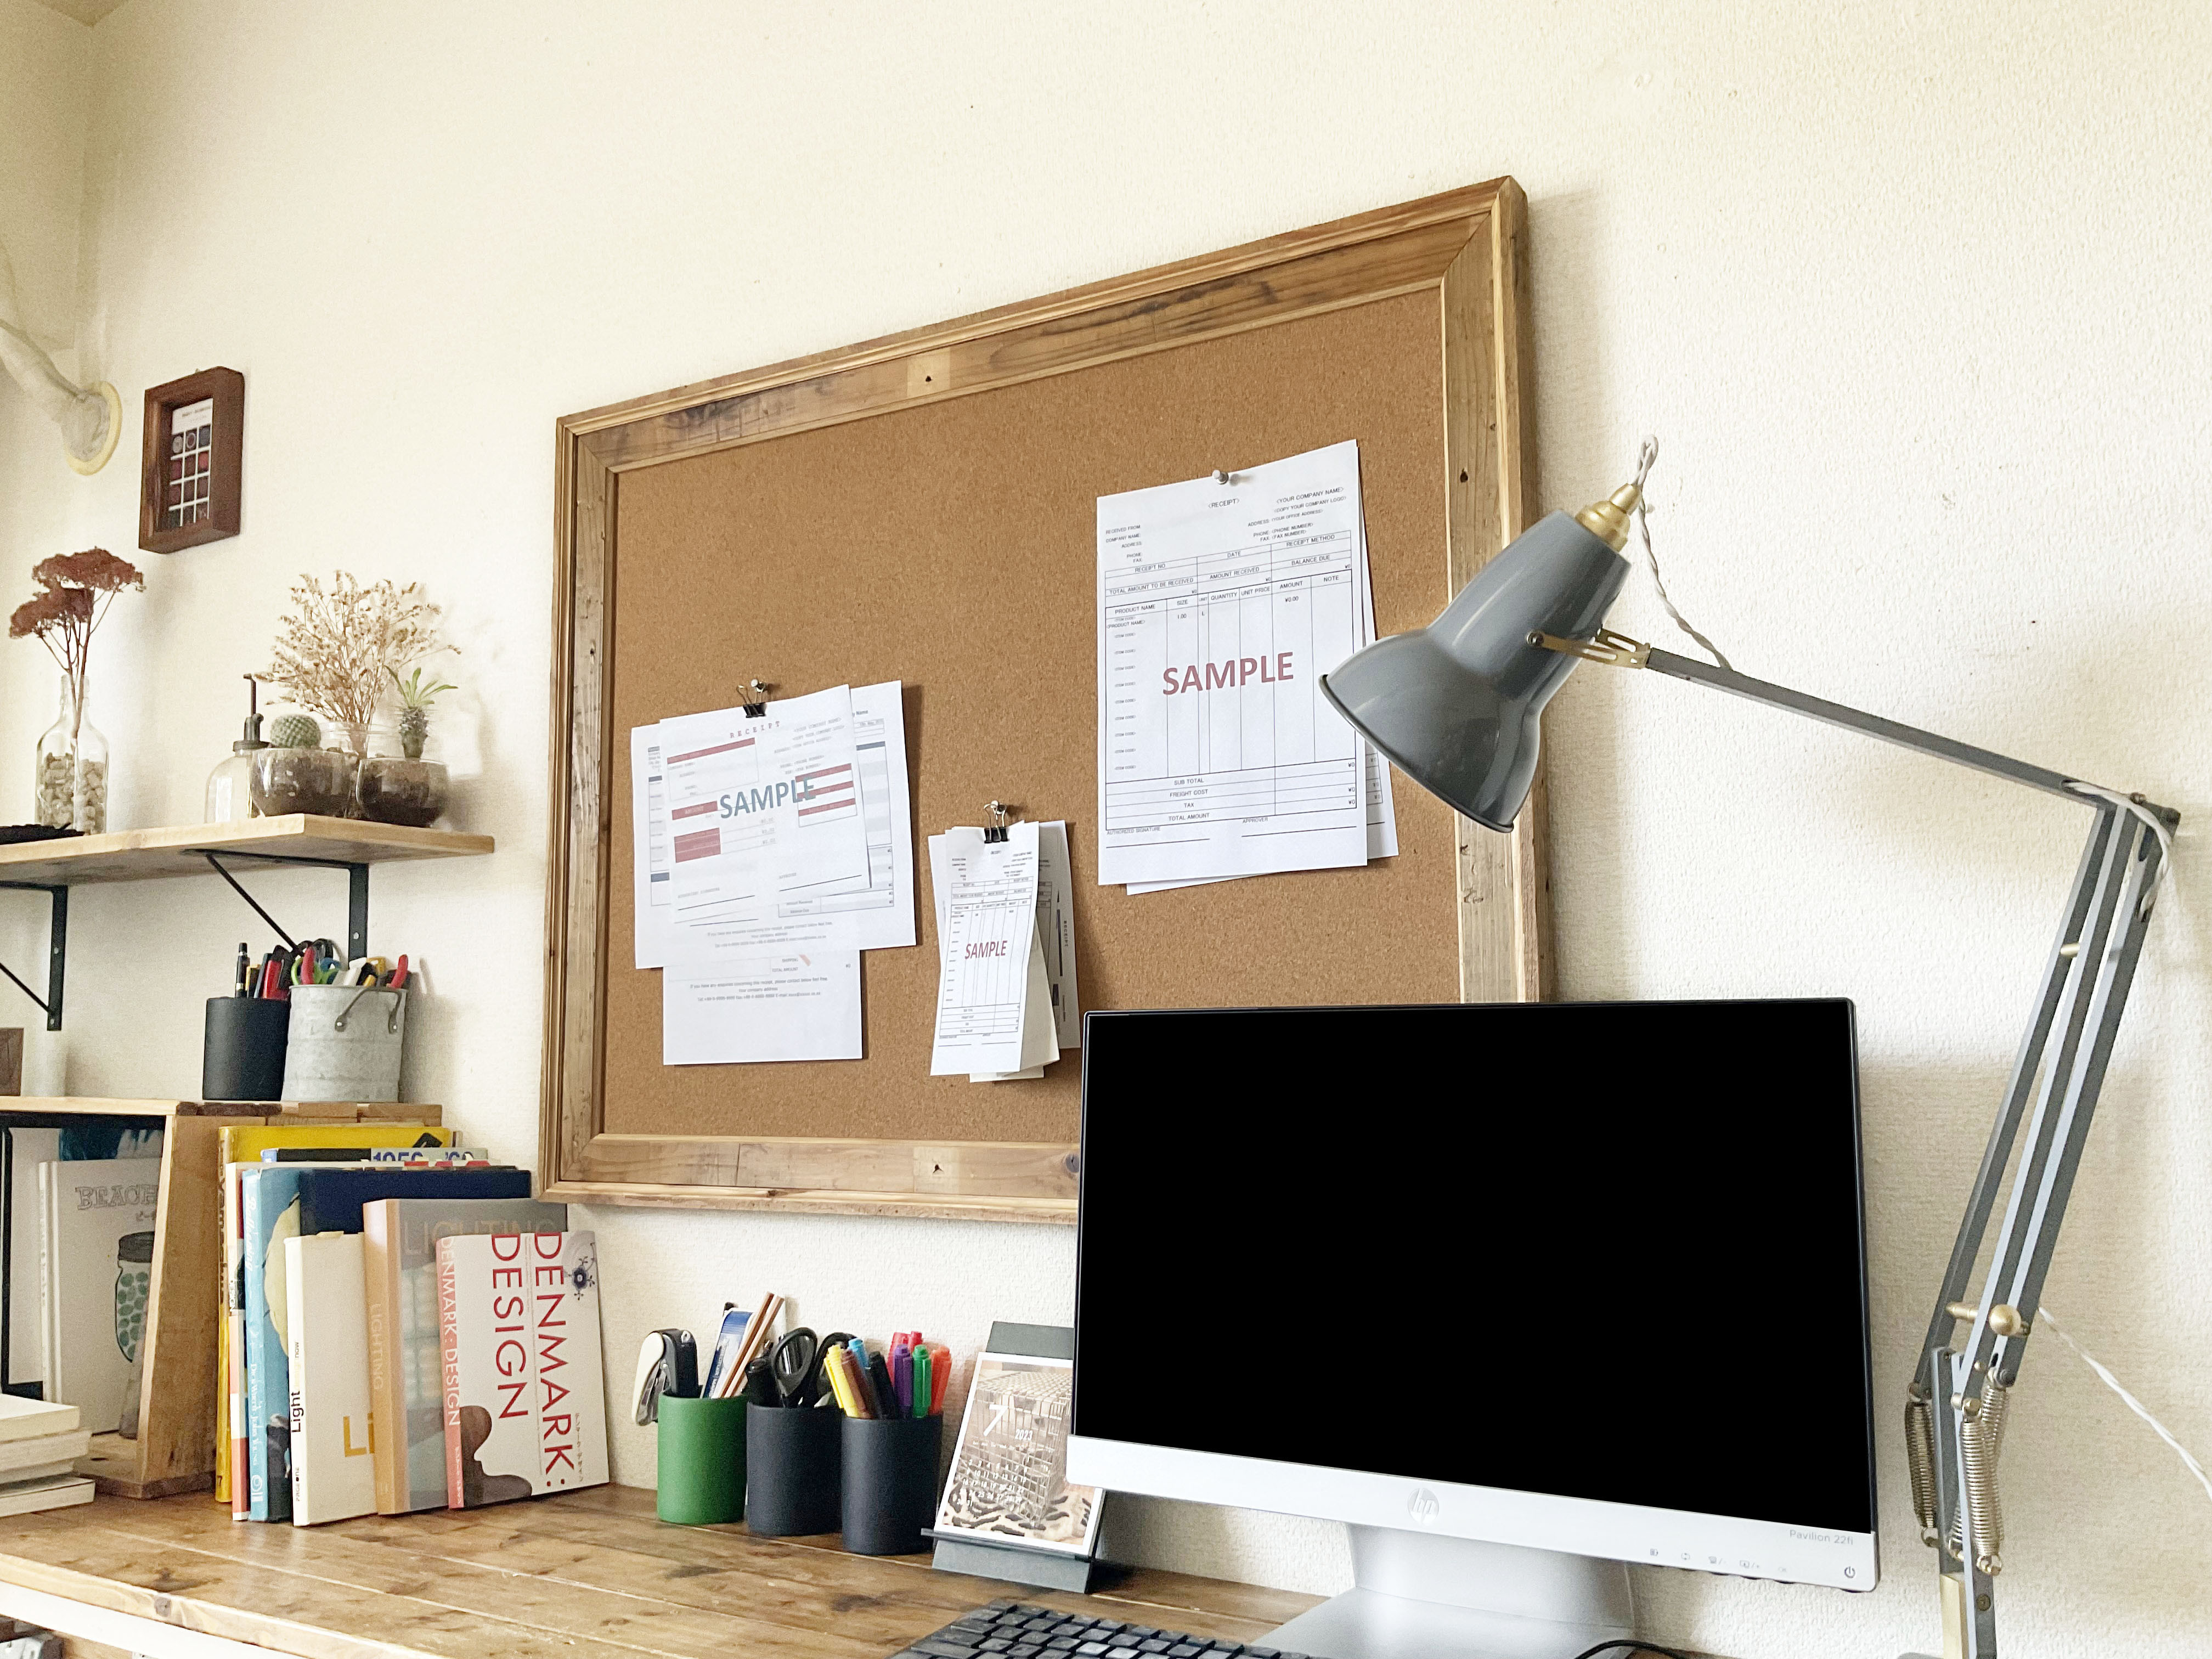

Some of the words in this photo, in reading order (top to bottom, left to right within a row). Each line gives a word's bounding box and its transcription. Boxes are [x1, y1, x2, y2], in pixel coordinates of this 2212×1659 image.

[1296, 491, 1323, 500] COMPANY
[1286, 538, 1310, 547] RECEIPT
[1311, 534, 1335, 543] METHOD
[1135, 564, 1156, 572] RECEIPT
[1291, 557, 1317, 566] BALANCE
[1168, 578, 1194, 586] RECEIVED
[1210, 571, 1232, 580] AMOUNT
[1234, 566, 1260, 575] RECEIVED
[1279, 580, 1303, 589] AMOUNT
[1211, 592, 1237, 601] QUANTITY
[1163, 652, 1294, 695] SAMPLE
[720, 777, 816, 819] SAMPLE
[964, 940, 1008, 960] SAMPLE
[75, 1184, 158, 1210] BEACH
[492, 1233, 528, 1419] DESIGN
[370, 1304, 383, 1390] LIGHTING
[445, 1350, 461, 1425] DESIGN
[290, 1390, 304, 1433] Light
[984, 1404, 1008, 1436] 7
[1015, 1429, 1033, 1440] 2023
[1410, 1487, 1438, 1525] hp
[1789, 1529, 1830, 1543] Pavilion
[1834, 1535, 1854, 1545] 22fi
